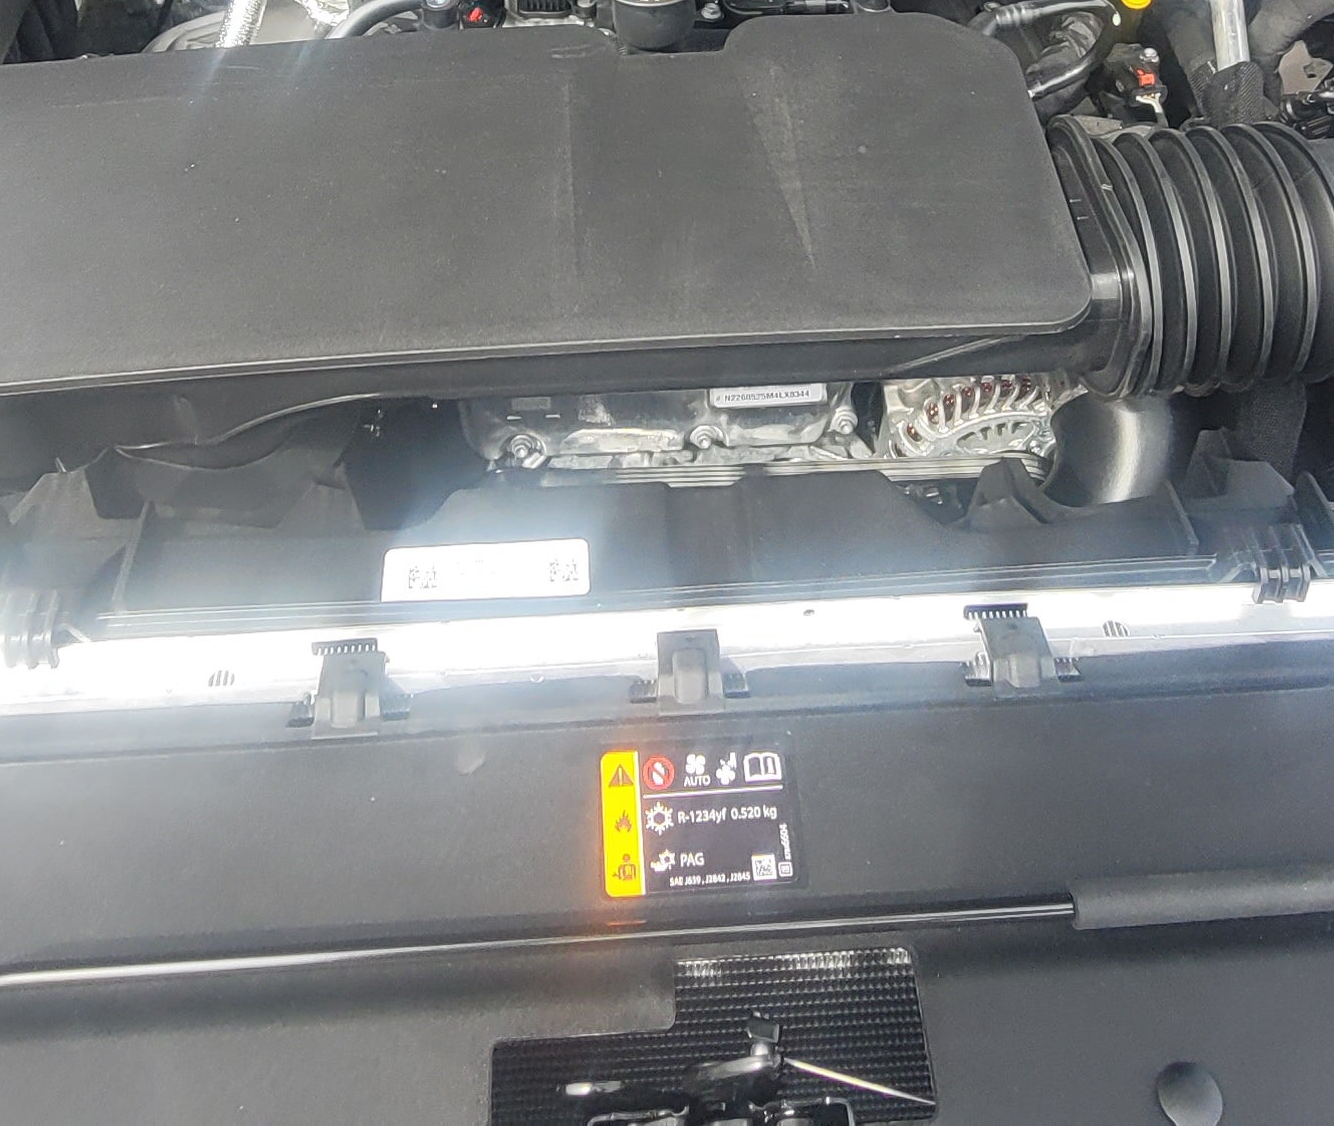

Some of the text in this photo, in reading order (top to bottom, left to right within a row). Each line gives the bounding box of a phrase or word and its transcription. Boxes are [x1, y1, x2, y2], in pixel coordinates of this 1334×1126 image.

[683, 775, 711, 788] AUTO
[677, 804, 778, 824] R-1234yf 0.520 kg
[679, 852, 705, 868] PAG
[669, 875, 684, 887] SAE
